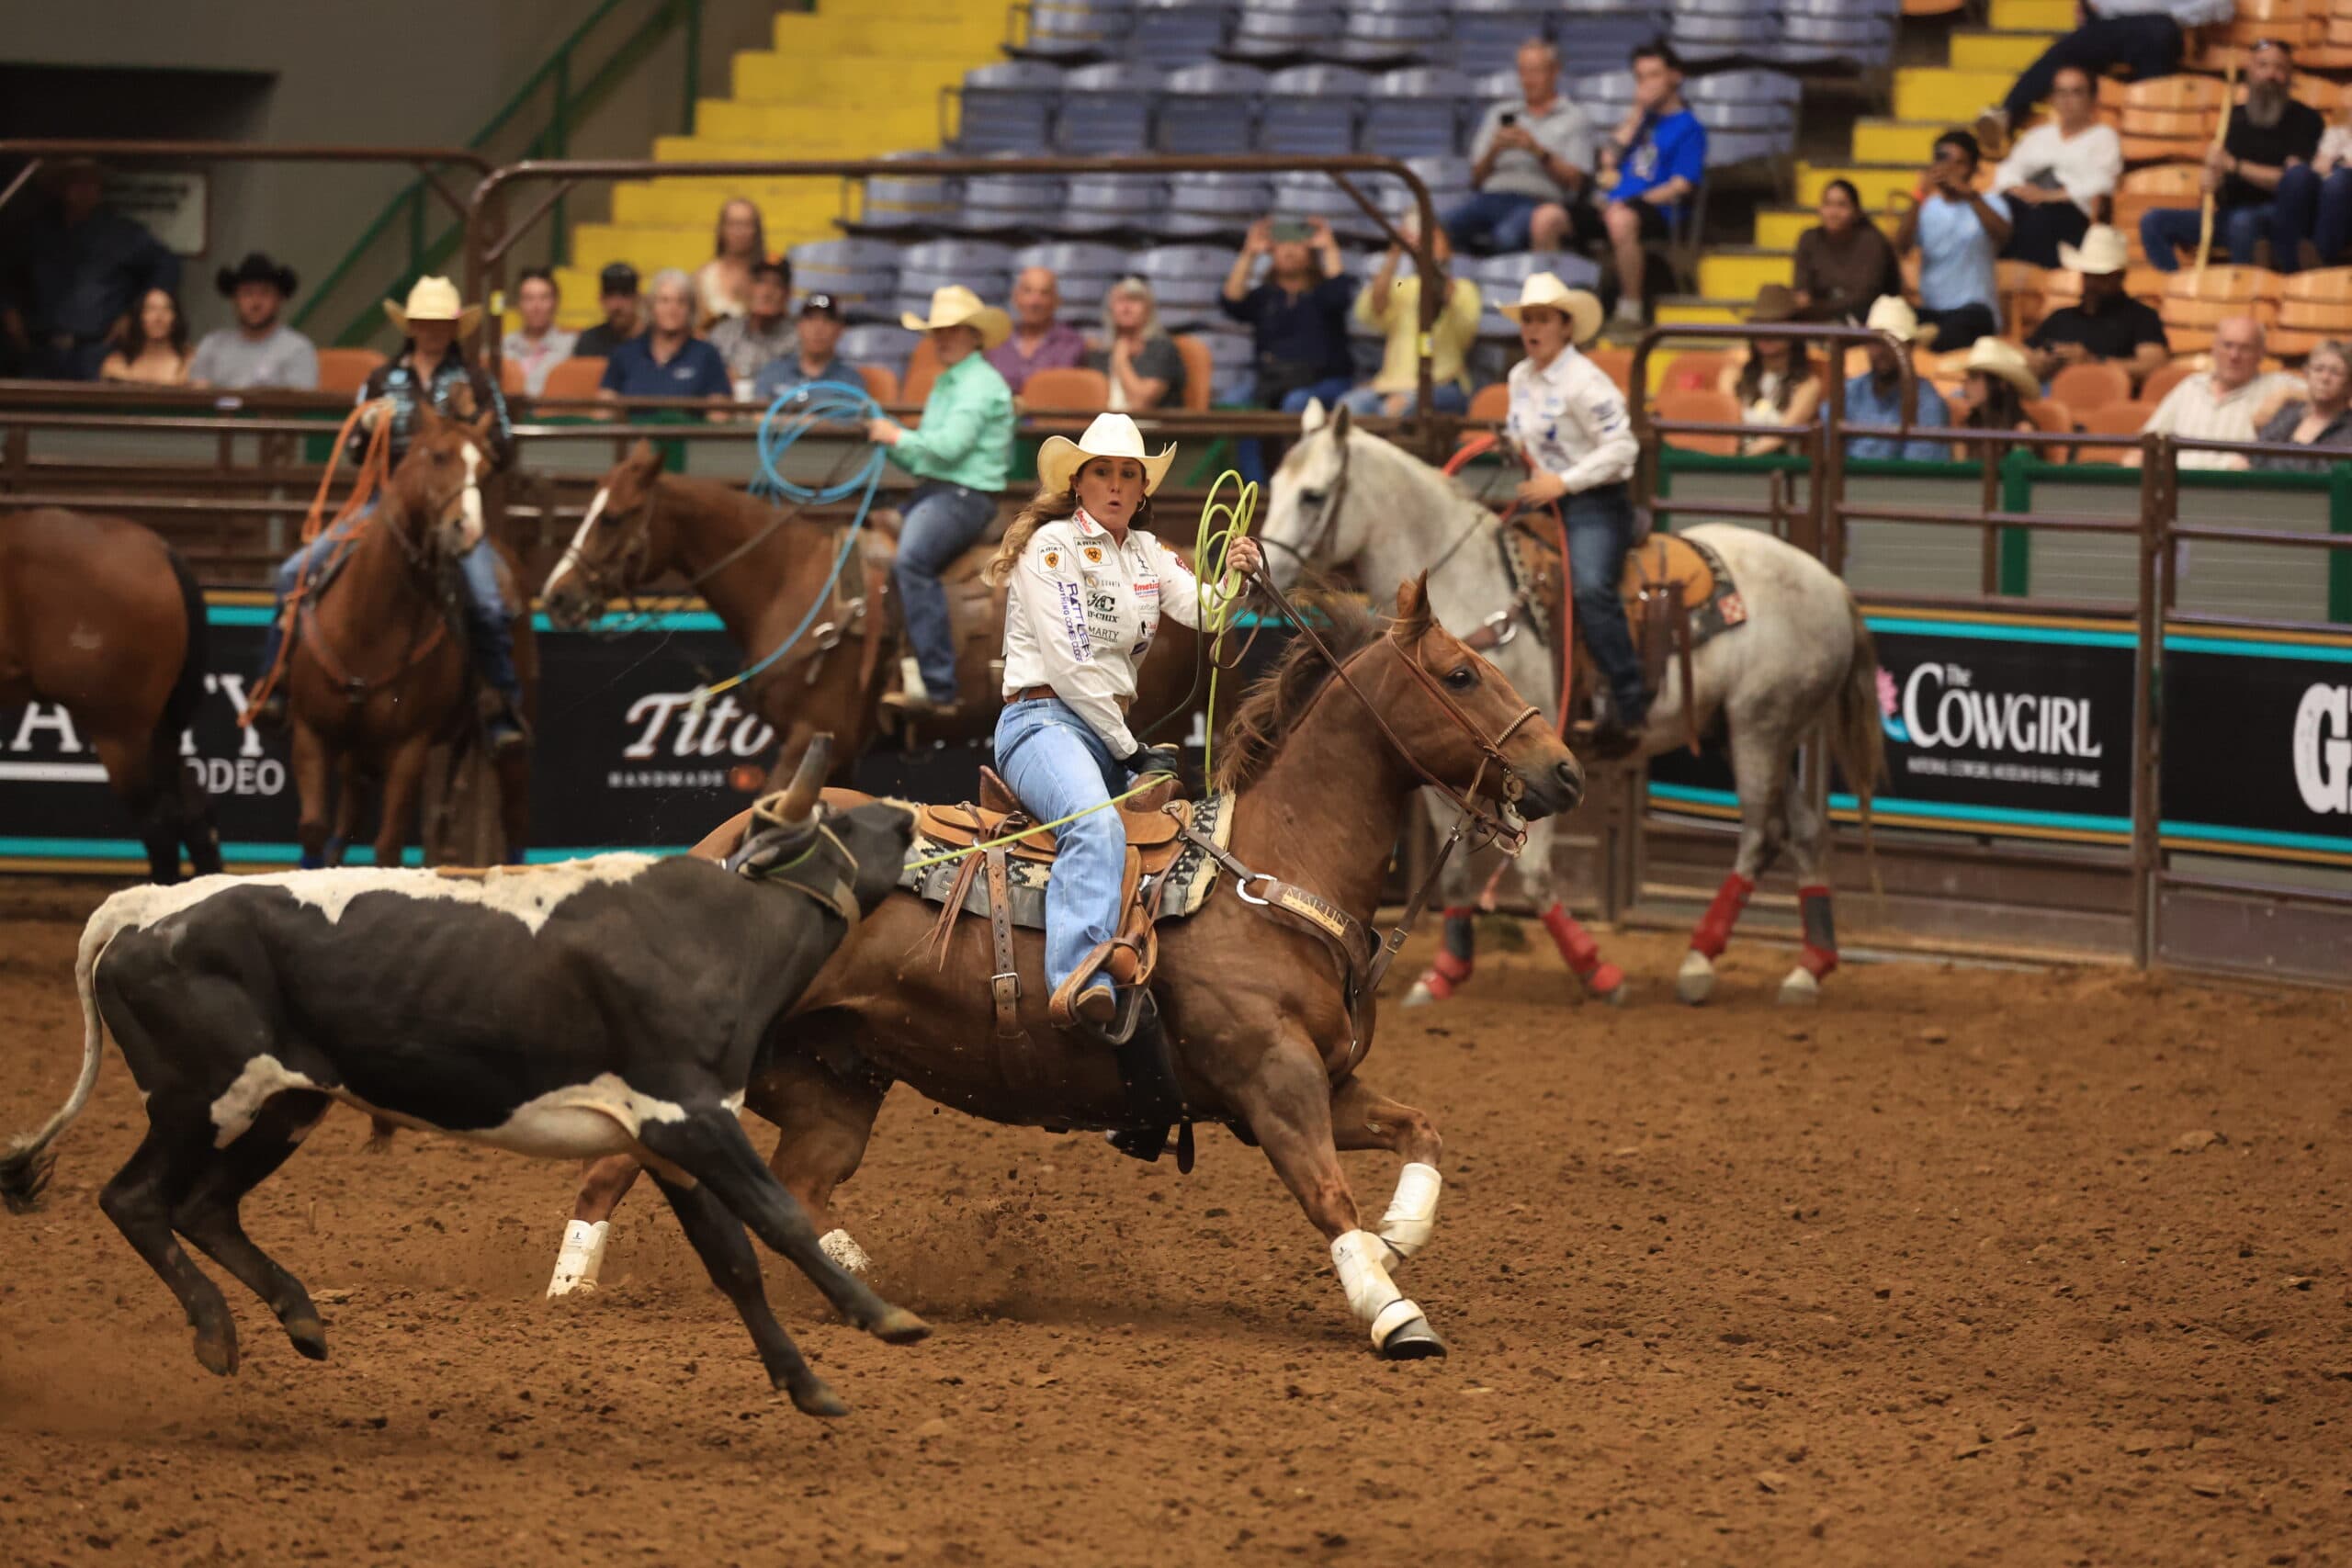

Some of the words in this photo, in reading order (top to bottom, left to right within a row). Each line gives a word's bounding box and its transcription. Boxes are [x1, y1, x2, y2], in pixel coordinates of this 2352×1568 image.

[1088, 626, 1119, 638] MARTY
[1946, 663, 1973, 687] The
[622, 692, 775, 759] Tito
